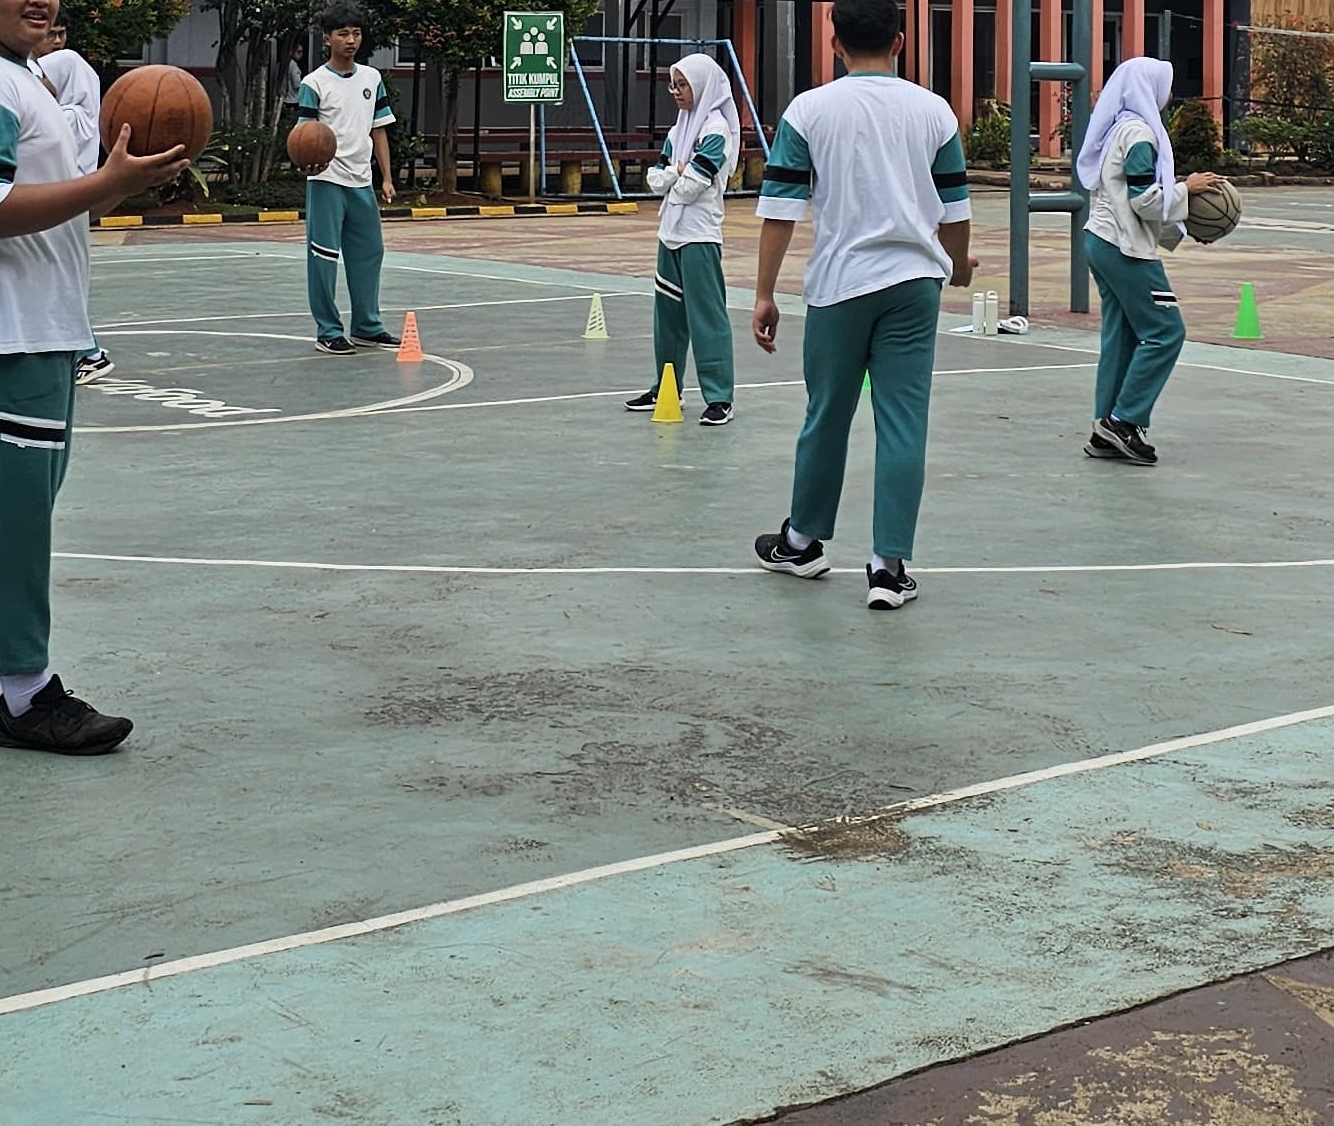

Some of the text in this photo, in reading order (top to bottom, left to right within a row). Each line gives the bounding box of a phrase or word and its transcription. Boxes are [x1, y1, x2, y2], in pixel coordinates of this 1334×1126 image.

[508, 73, 559, 84] TITIK KUMPUL
[508, 88, 559, 98] ASSEMBLY POINT
